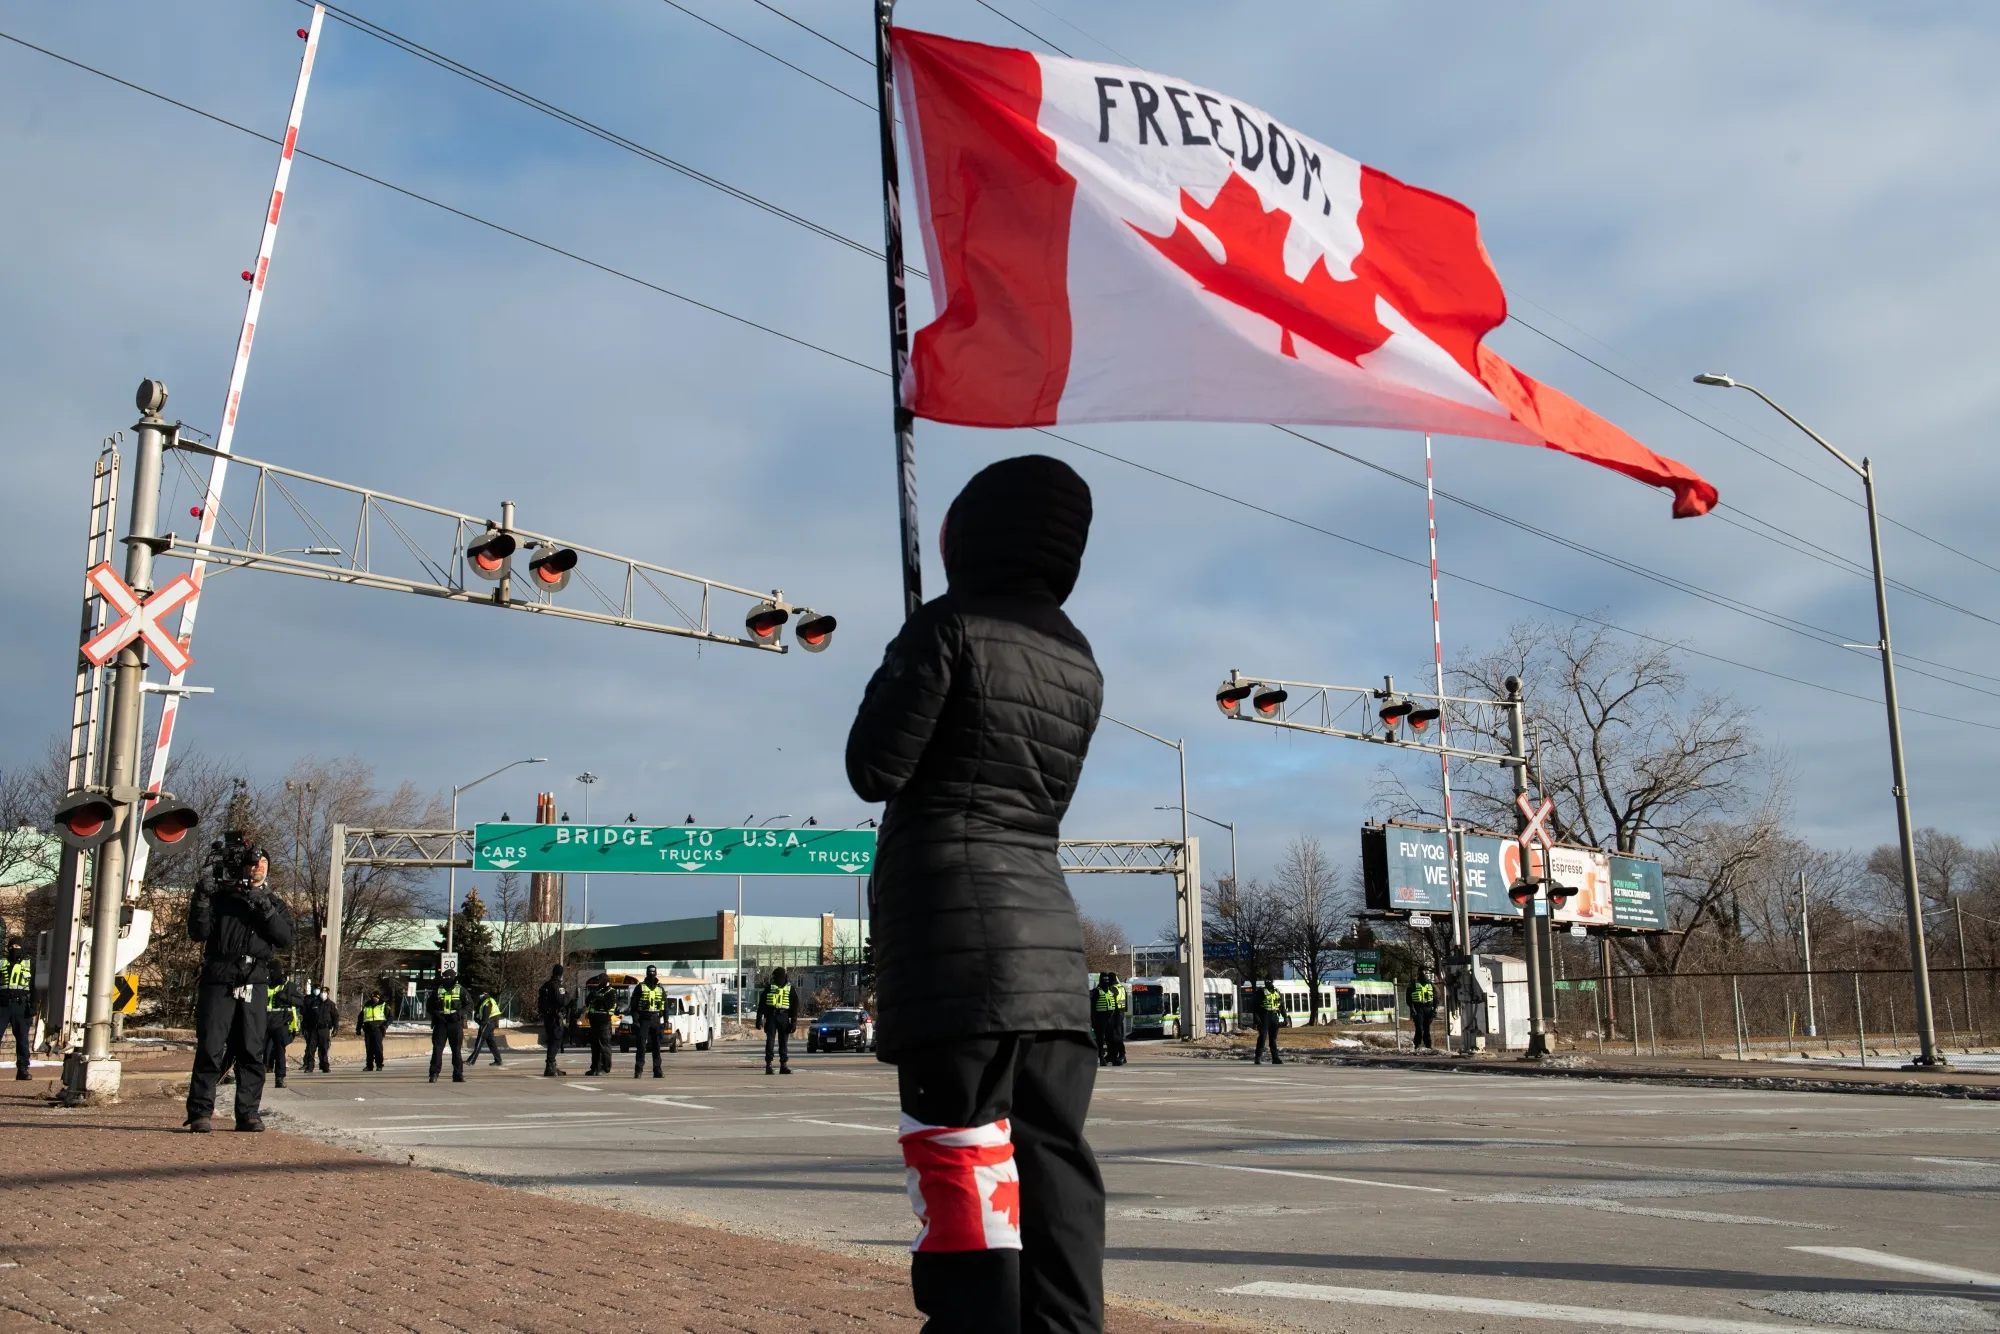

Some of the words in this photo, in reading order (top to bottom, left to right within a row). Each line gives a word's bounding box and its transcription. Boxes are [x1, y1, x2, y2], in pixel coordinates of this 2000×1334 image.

[1094, 76, 1332, 217] FREEDOM
[556, 827, 654, 846] BRIDGE
[685, 830, 713, 847] TO
[743, 831, 807, 848] U.S.A.
[481, 845, 528, 859] CARS
[659, 848, 724, 862] TRUCKS
[808, 851, 871, 863] TRUCKS
[1400, 842, 1418, 857] FLY
[1421, 844, 1445, 860] YQG
[1424, 866, 1448, 885] WE
[1552, 859, 1583, 876] Espresso
[444, 960, 456, 969] 50
